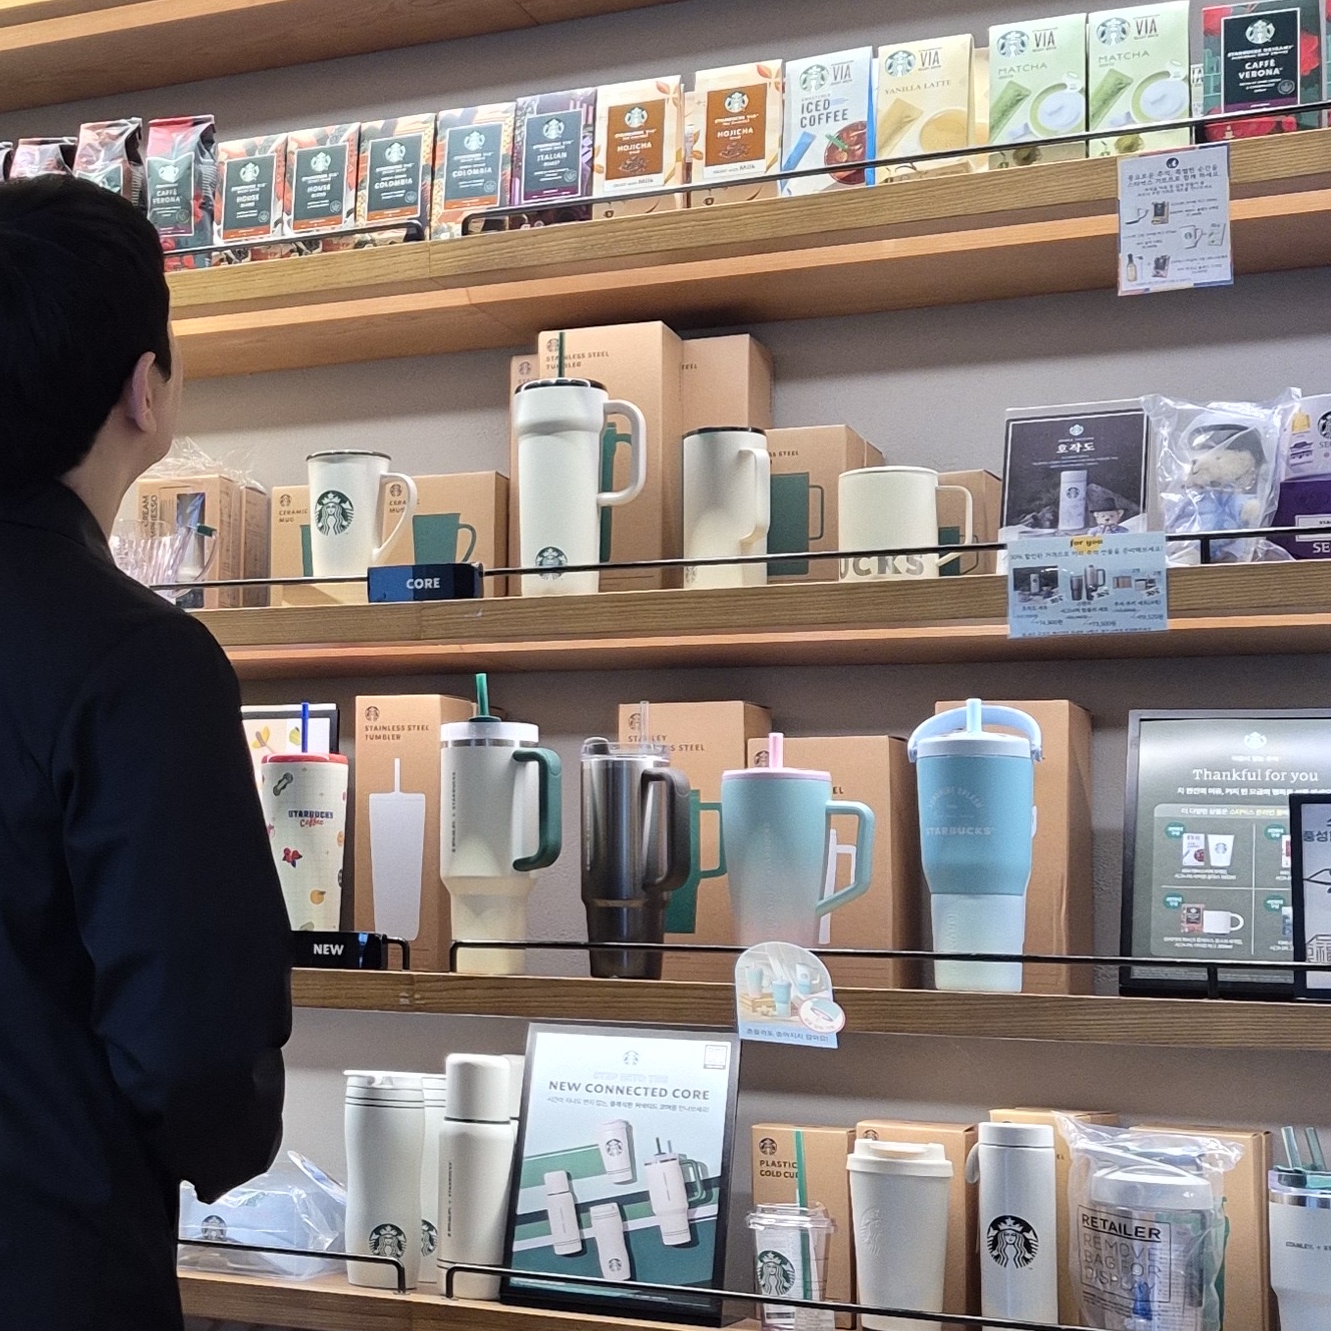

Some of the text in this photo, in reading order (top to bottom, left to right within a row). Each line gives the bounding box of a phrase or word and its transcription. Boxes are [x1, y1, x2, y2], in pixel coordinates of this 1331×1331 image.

[1135, 18, 1158, 36] VIA
[1034, 31, 1056, 48] VIA
[920, 50, 941, 67] VIA
[1098, 50, 1150, 63] MATCHA
[833, 64, 852, 82] VIA
[997, 62, 1048, 75] MATCHA
[1238, 68, 1281, 79] VERONA
[884, 80, 952, 95] VANILLA LATTE
[800, 99, 831, 115] ICED
[800, 108, 849, 128] COFFEE
[717, 127, 754, 139] HOJICHA
[617, 141, 653, 152] HOJICHA
[452, 167, 492, 178] COLOMBIA
[374, 178, 413, 189] COLOMBIA
[546, 353, 586, 362] STANLESS
[546, 361, 582, 370] TUBLER
[278, 508, 308, 516] CERAMIC
[1070, 539, 1084, 547] for
[405, 577, 441, 590] CORE
[1192, 767, 1319, 783] Thankful for you
[288, 810, 333, 819] STARBUCKS
[300, 817, 324, 828] Coffee
[926, 826, 991, 835] STARBUCKS
[312, 943, 344, 956] NEW
[548, 1080, 710, 1100] NEW CONNECTED CORE
[759, 1159, 798, 1170] PLASTIC
[759, 1169, 783, 1178] COLD
[1081, 1213, 1162, 1239] RETAILER
[1083, 1233, 1158, 1262] REMOVE
[1084, 1249, 1162, 1278] BAG FOR
